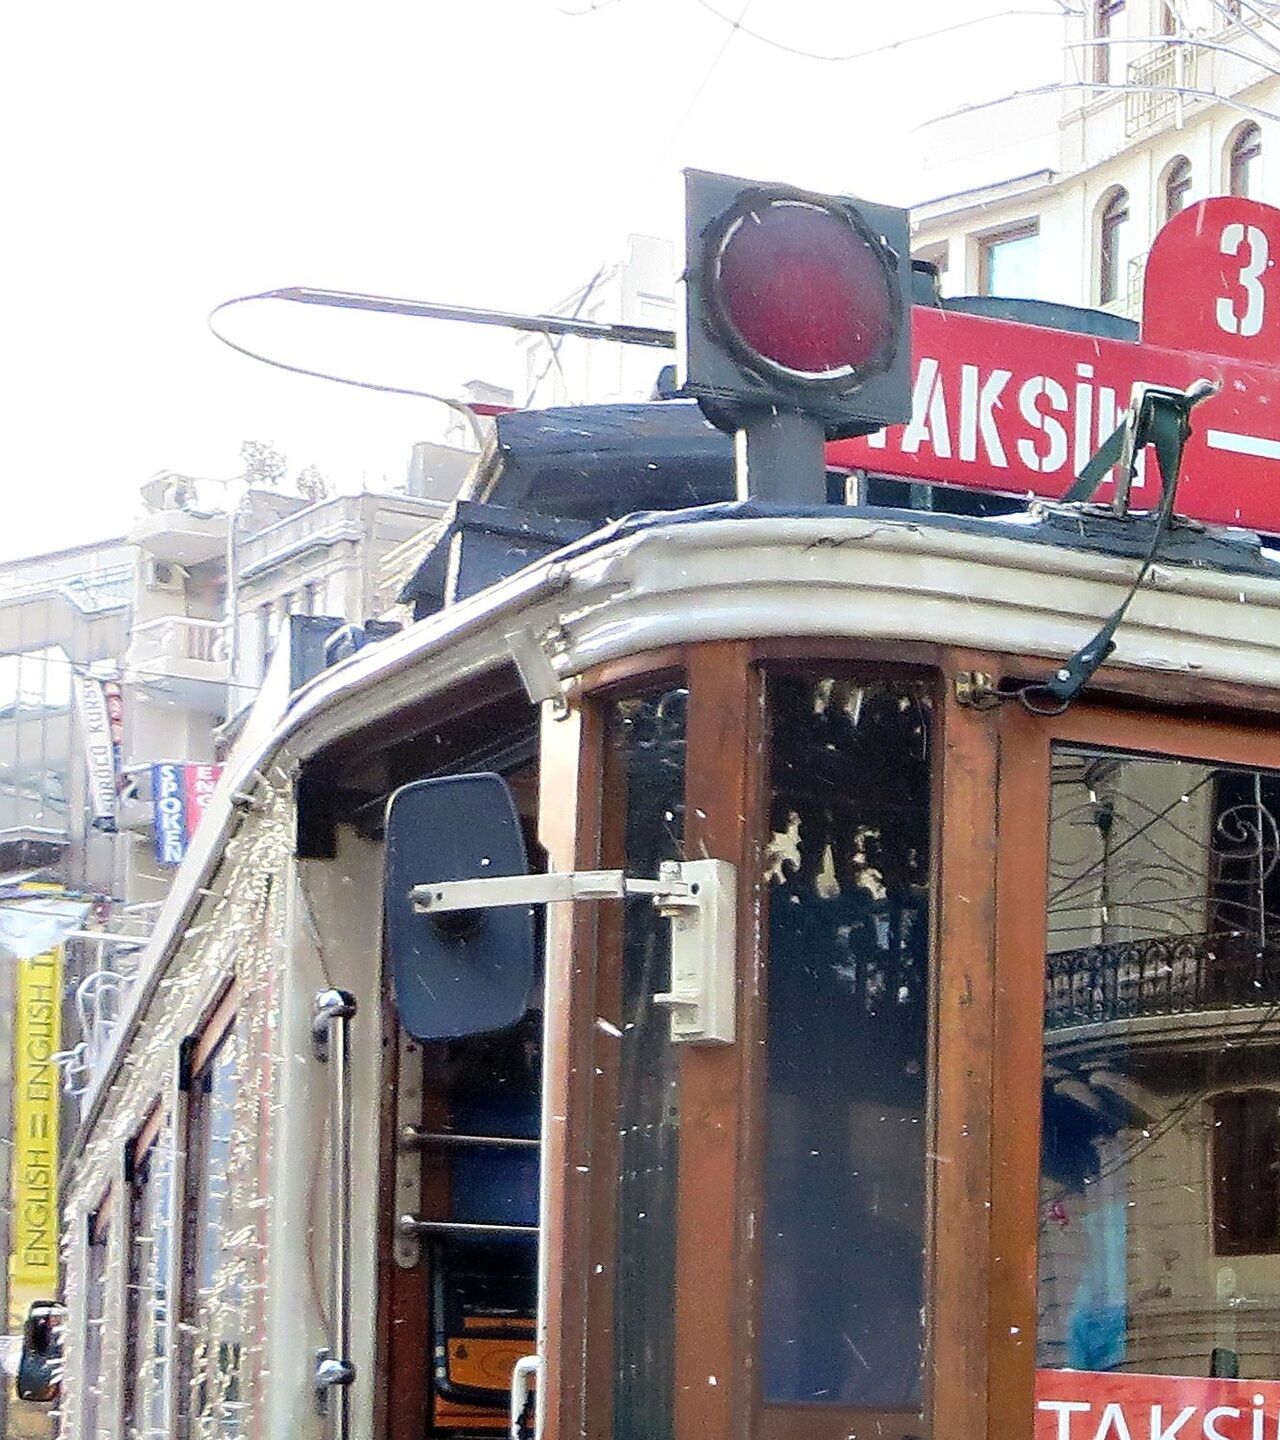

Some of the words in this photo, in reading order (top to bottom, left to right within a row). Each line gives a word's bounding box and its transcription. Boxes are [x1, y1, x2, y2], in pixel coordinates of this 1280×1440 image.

[1216, 223, 1270, 338] 3
[867, 358, 1147, 488] AKSİ
[160, 765, 185, 862] SPOKEN
[27, 984, 53, 1101] ENGLISH
[25, 1149, 50, 1267] ENGLISH
